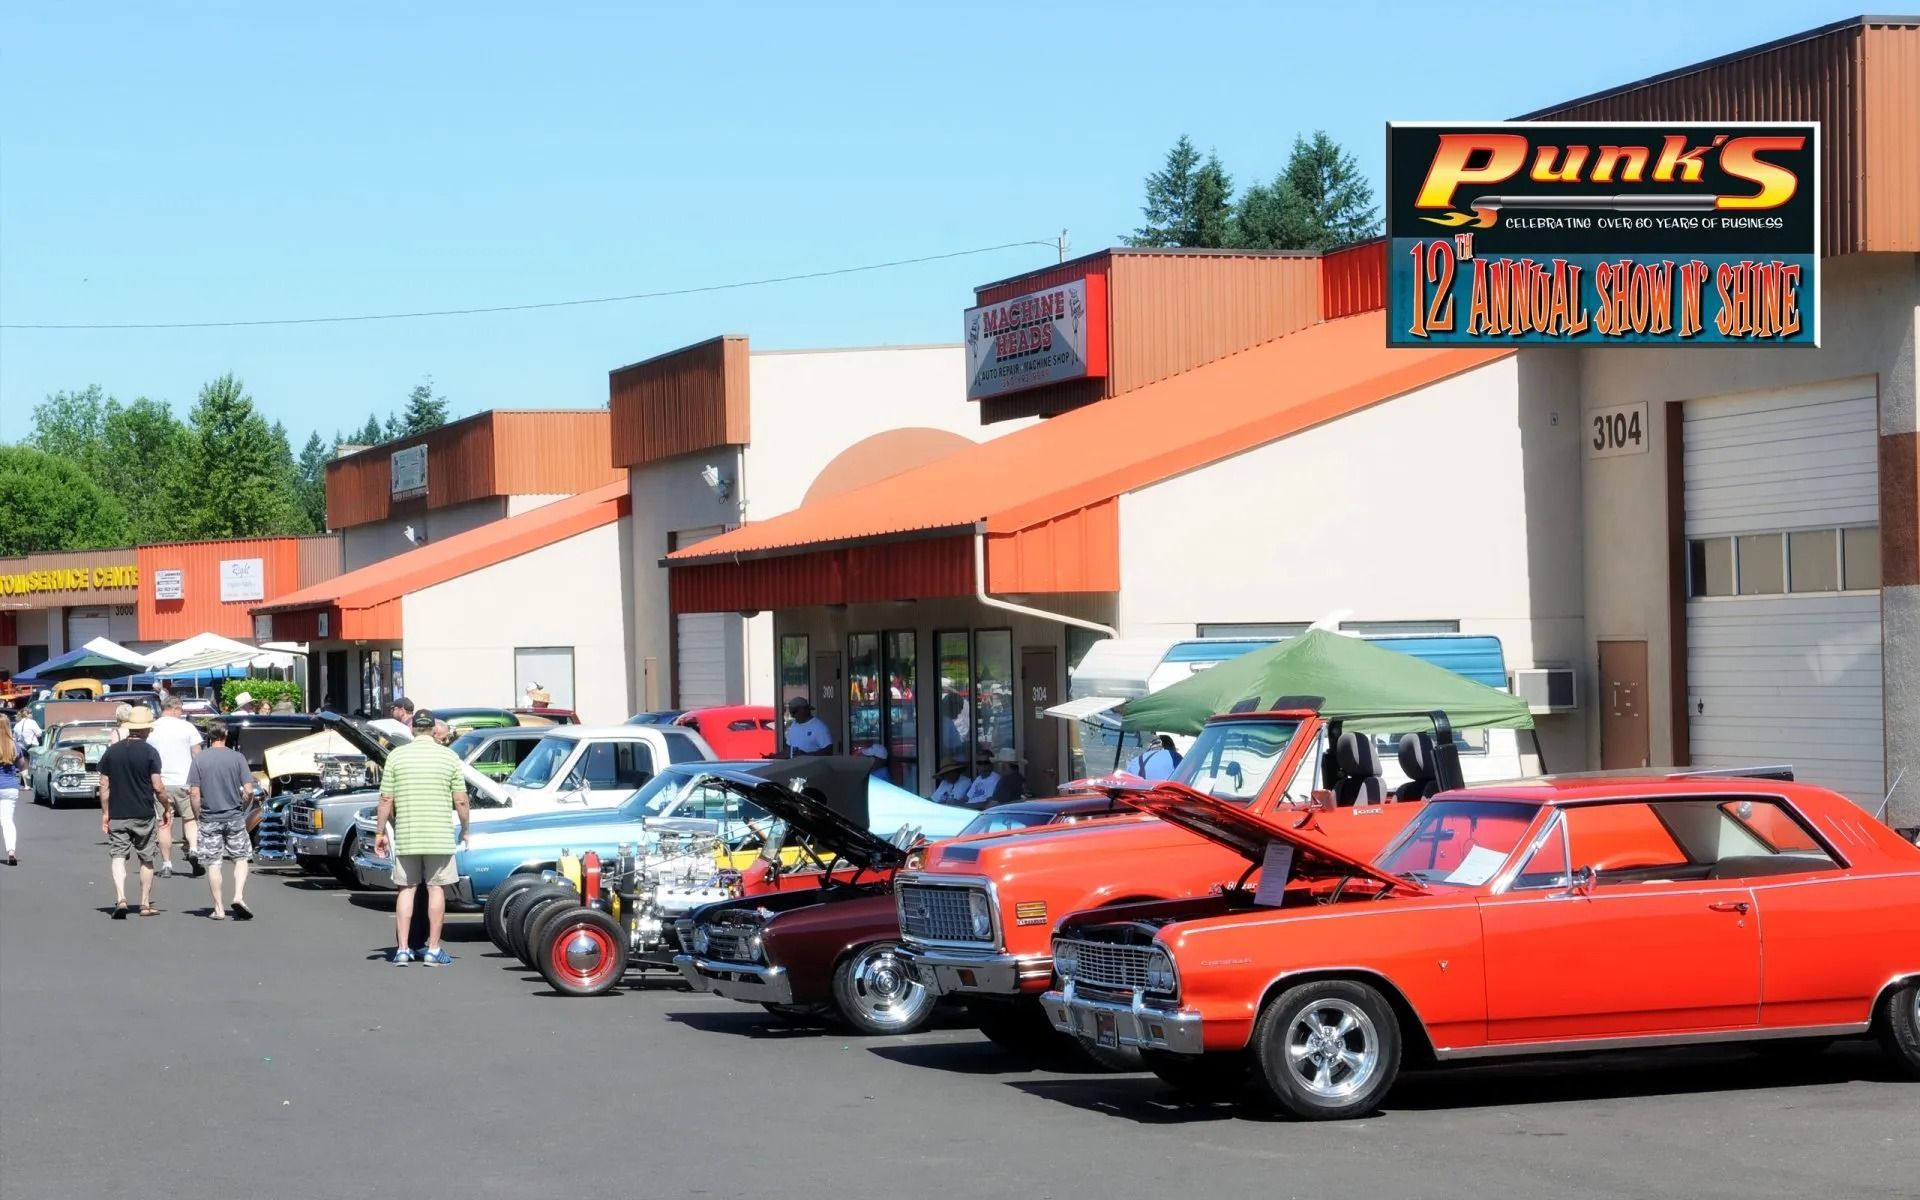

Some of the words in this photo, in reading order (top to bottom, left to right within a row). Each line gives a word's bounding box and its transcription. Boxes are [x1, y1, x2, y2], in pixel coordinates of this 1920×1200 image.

[983, 291, 1065, 334] MACHINE
[996, 324, 1053, 360] HEADS
[981, 368, 998, 381] AUTO
[999, 363, 1019, 377] REPAIR
[1023, 356, 1052, 372] MACHINE
[1052, 351, 1070, 366] SHOP
[1593, 411, 1642, 450] 3104
[28, 568, 89, 591] SERVICE
[1032, 686, 1047, 702] 3104
